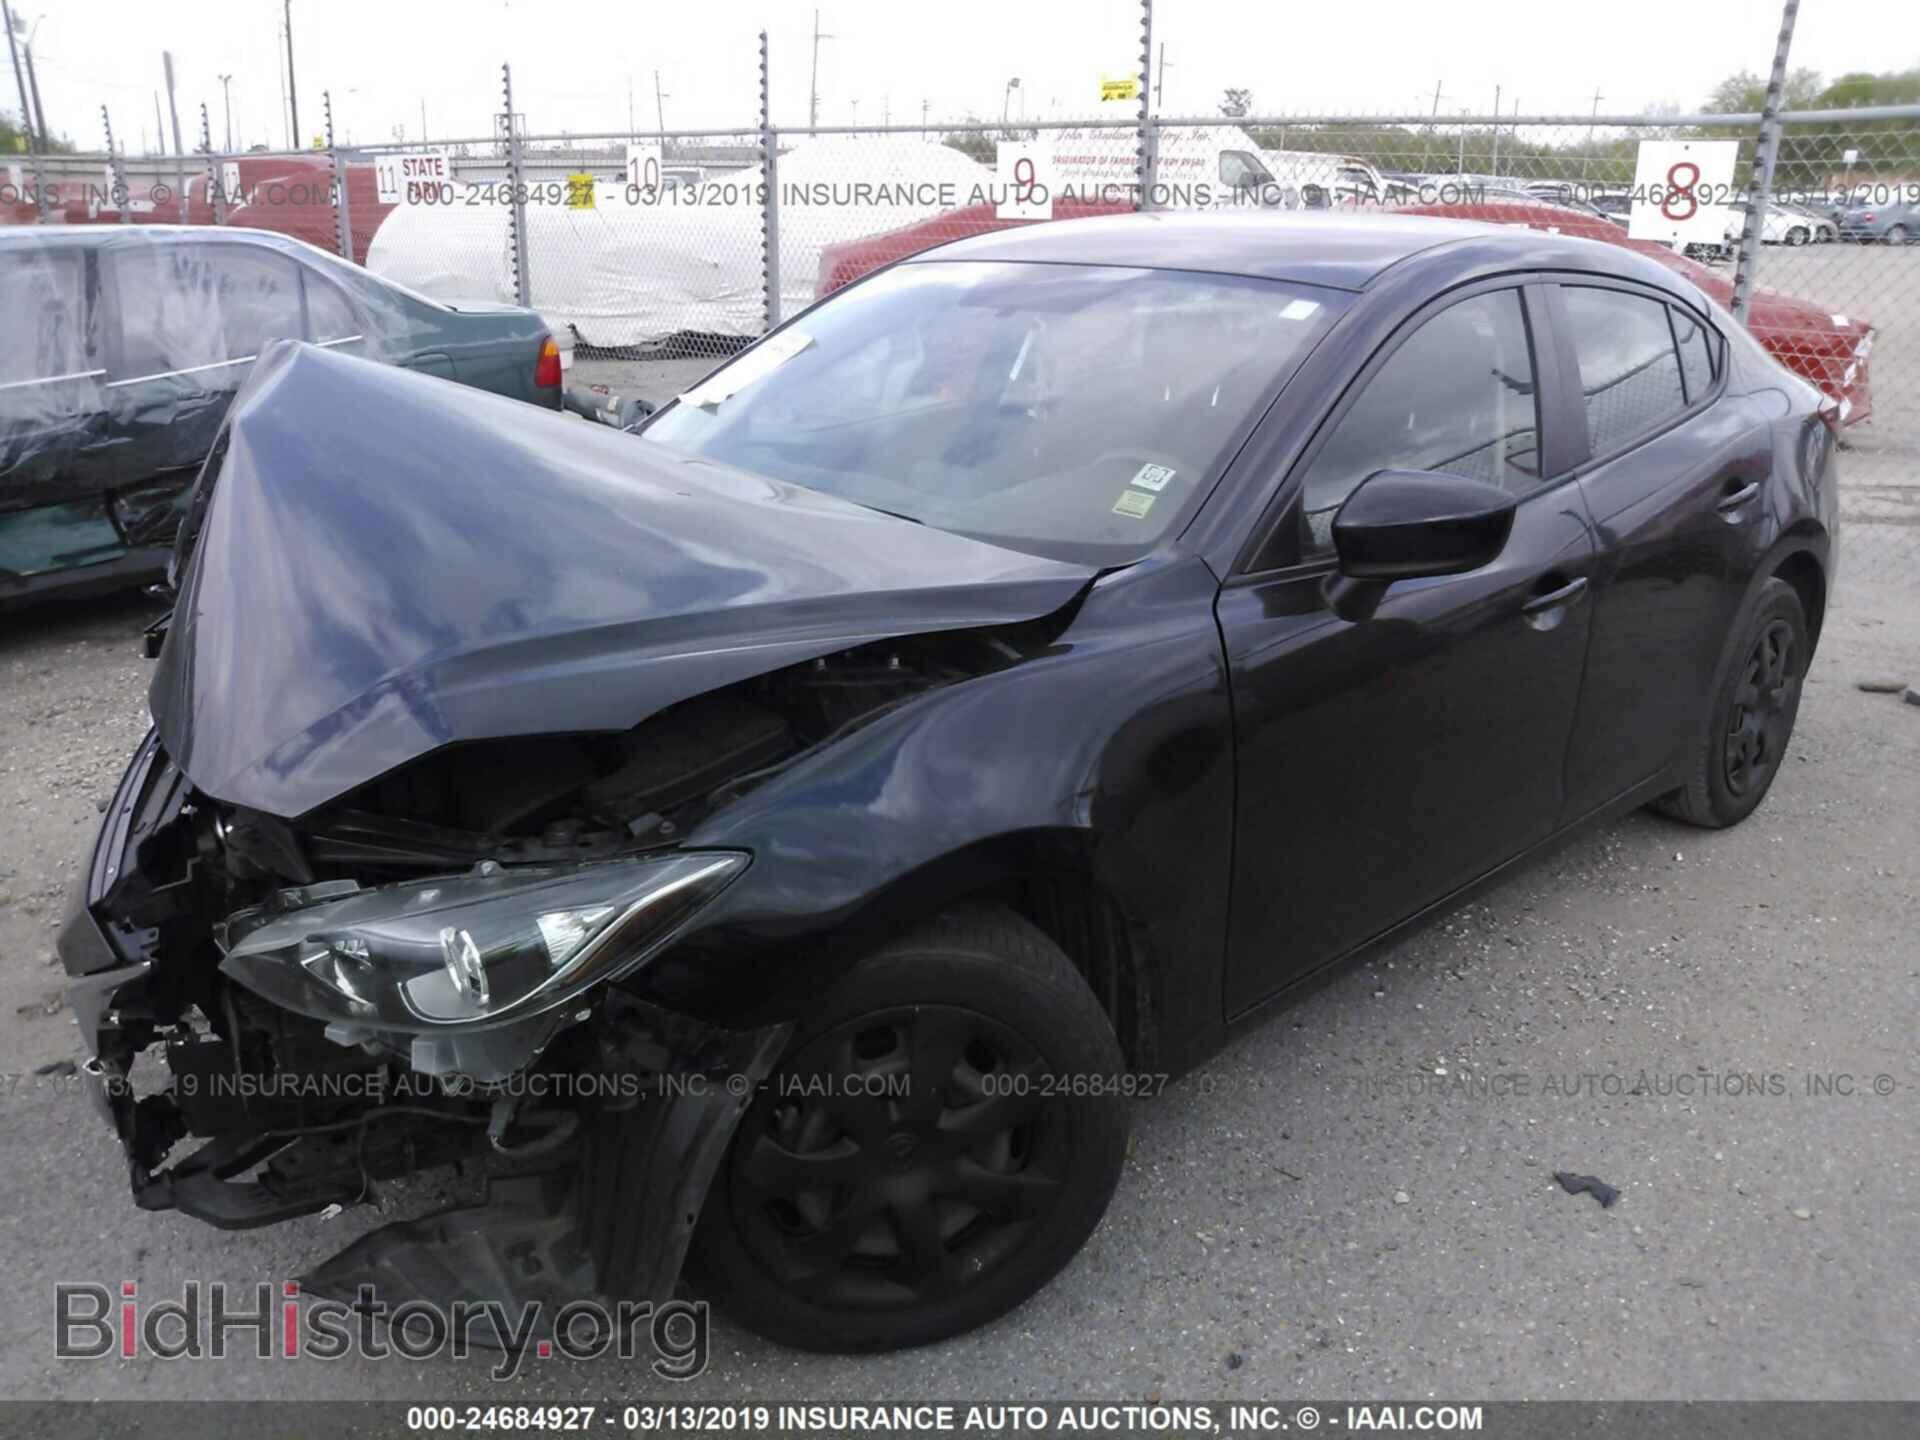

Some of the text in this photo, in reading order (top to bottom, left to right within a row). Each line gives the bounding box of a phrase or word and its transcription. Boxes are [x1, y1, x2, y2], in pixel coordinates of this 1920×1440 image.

[402, 158, 444, 177] STATE
[629, 157, 660, 193] 10
[1013, 157, 1037, 203] 9
[1661, 161, 1701, 221] 8
